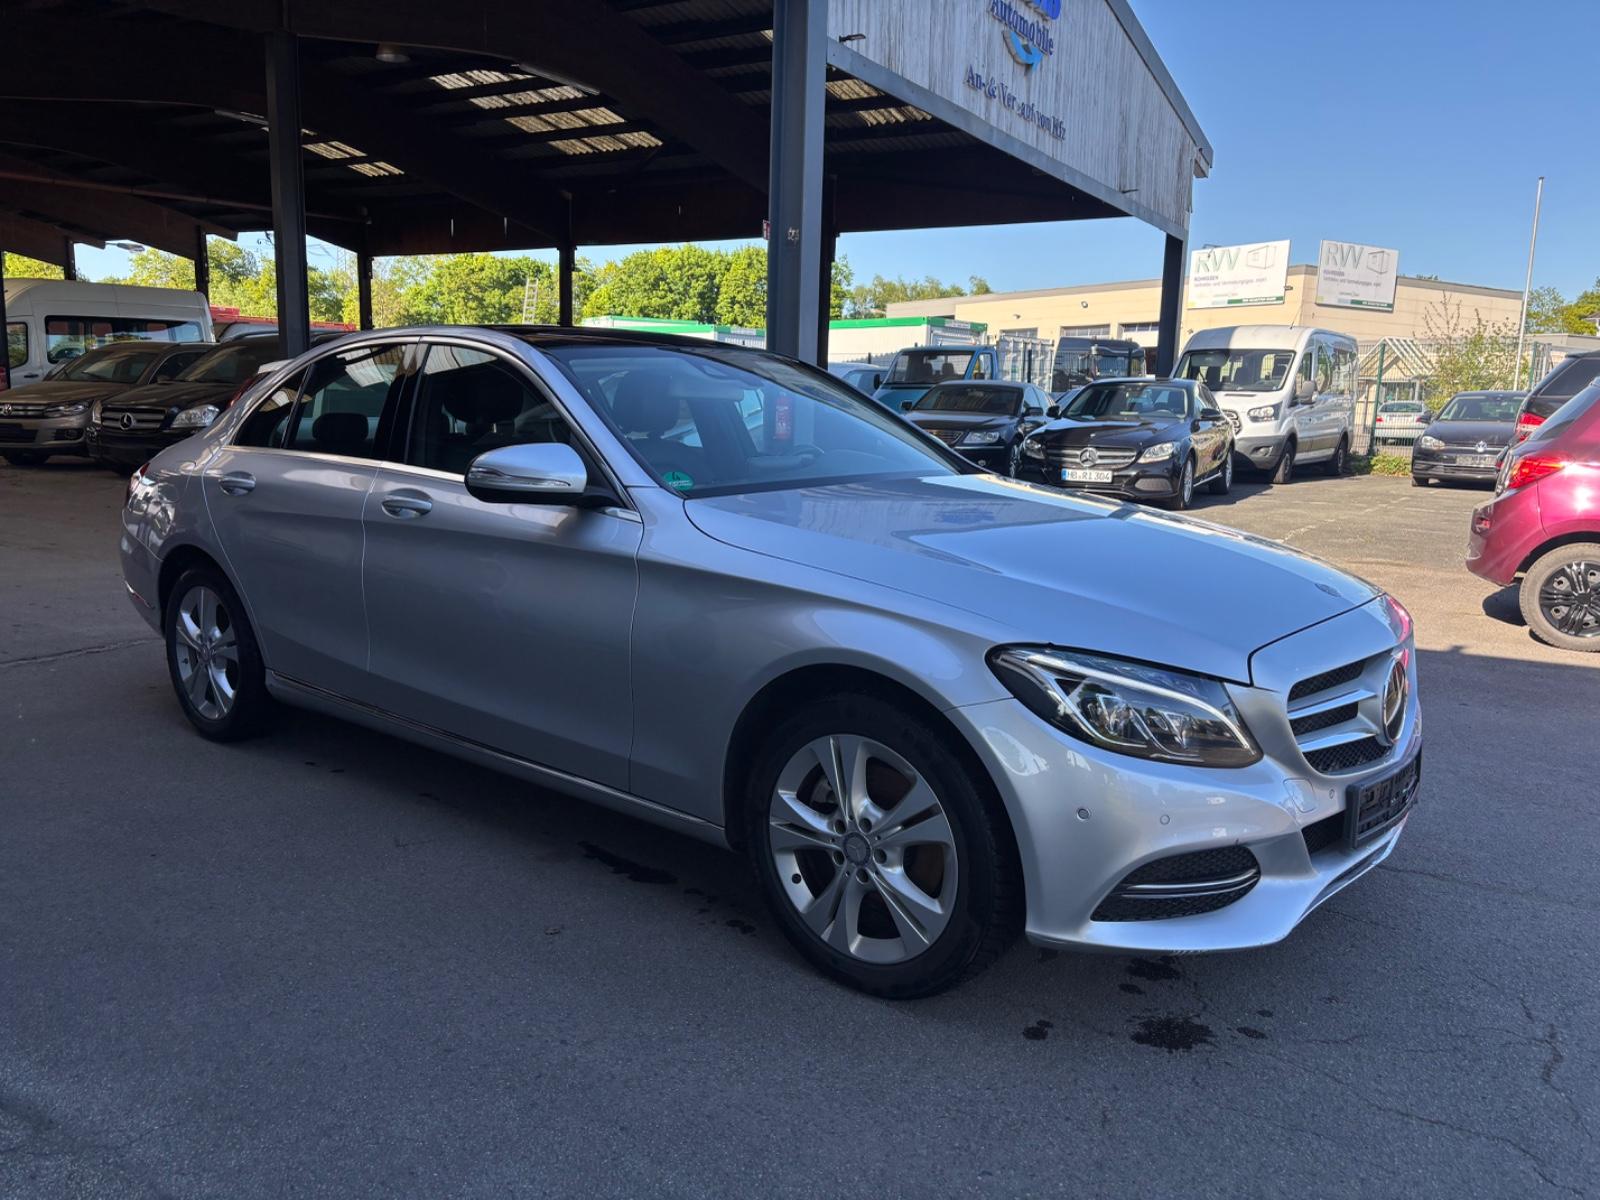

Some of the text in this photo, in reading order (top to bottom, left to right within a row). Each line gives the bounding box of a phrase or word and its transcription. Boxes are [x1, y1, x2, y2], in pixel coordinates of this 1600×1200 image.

[991, 0, 1054, 55] Automobile
[967, 65, 986, 90] An-
[987, 77, 997, 99] &
[1196, 247, 1241, 273] RW
[1326, 243, 1364, 269] RW
[1094, 472, 1110, 481] 304
